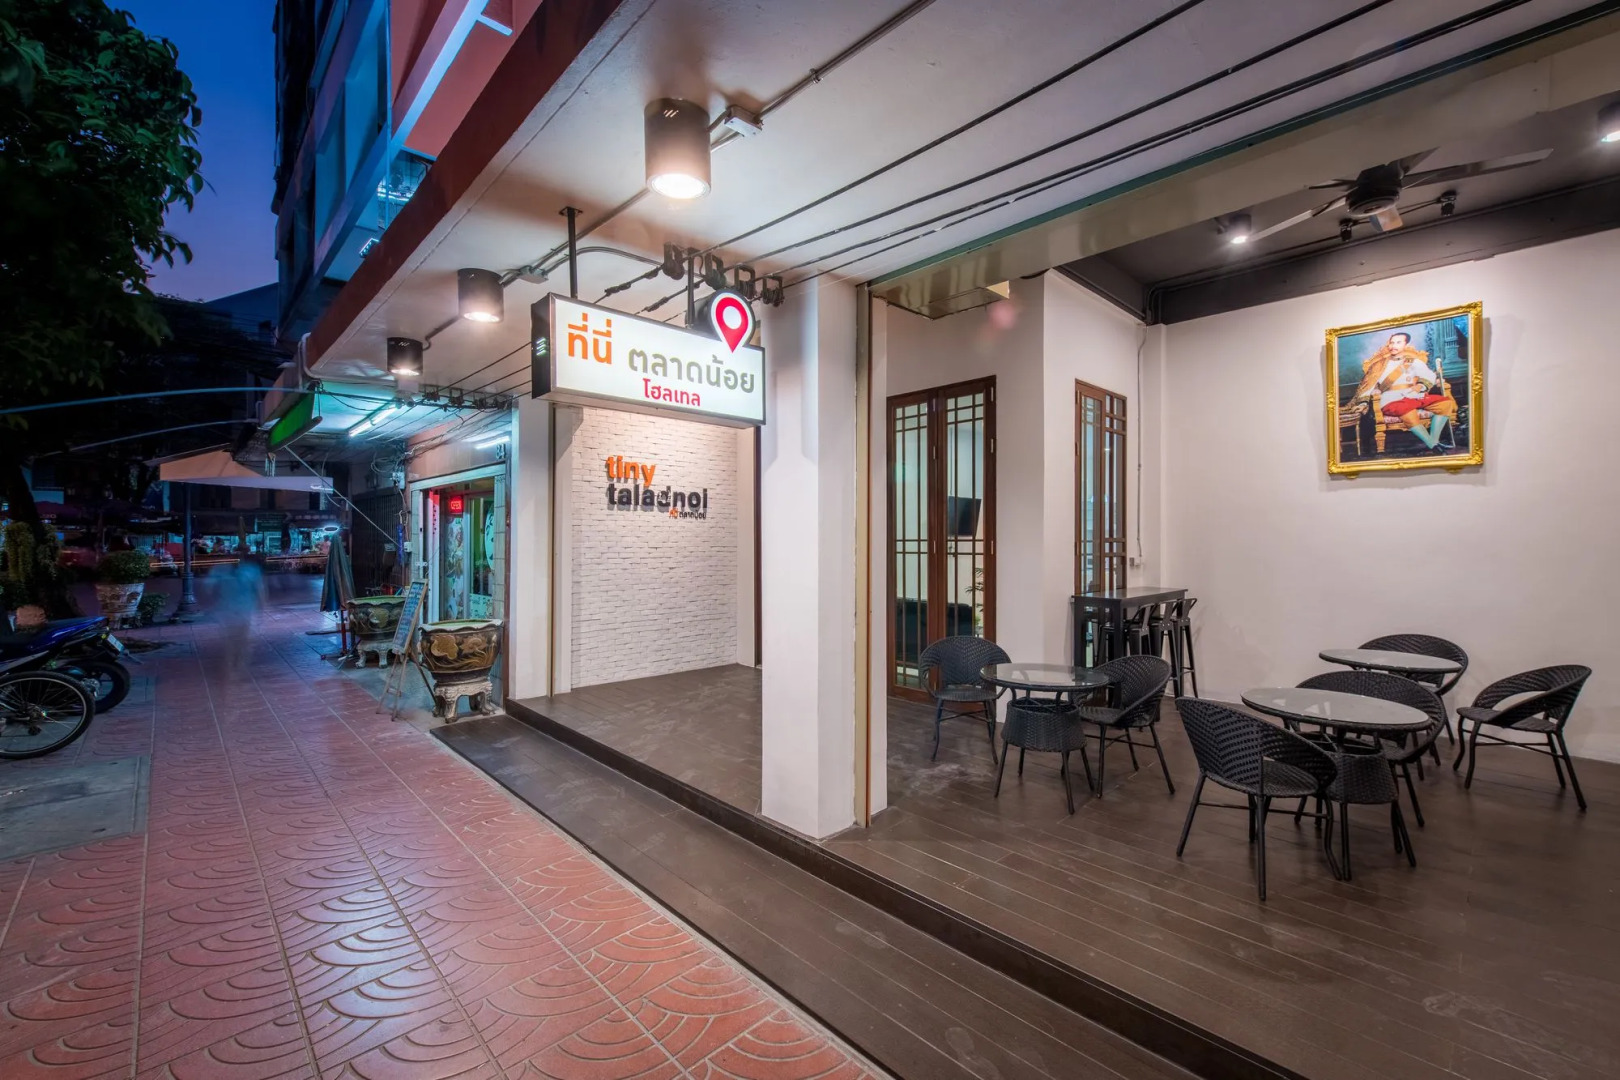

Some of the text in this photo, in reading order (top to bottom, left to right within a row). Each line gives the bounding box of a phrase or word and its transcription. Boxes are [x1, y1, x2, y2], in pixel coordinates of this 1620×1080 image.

[567, 313, 755, 394] ที่นี่ ตลาดน้อย
[643, 378, 701, 406] โฮลเทล
[607, 456, 656, 488] tiny
[608, 483, 708, 508] taladnoi
